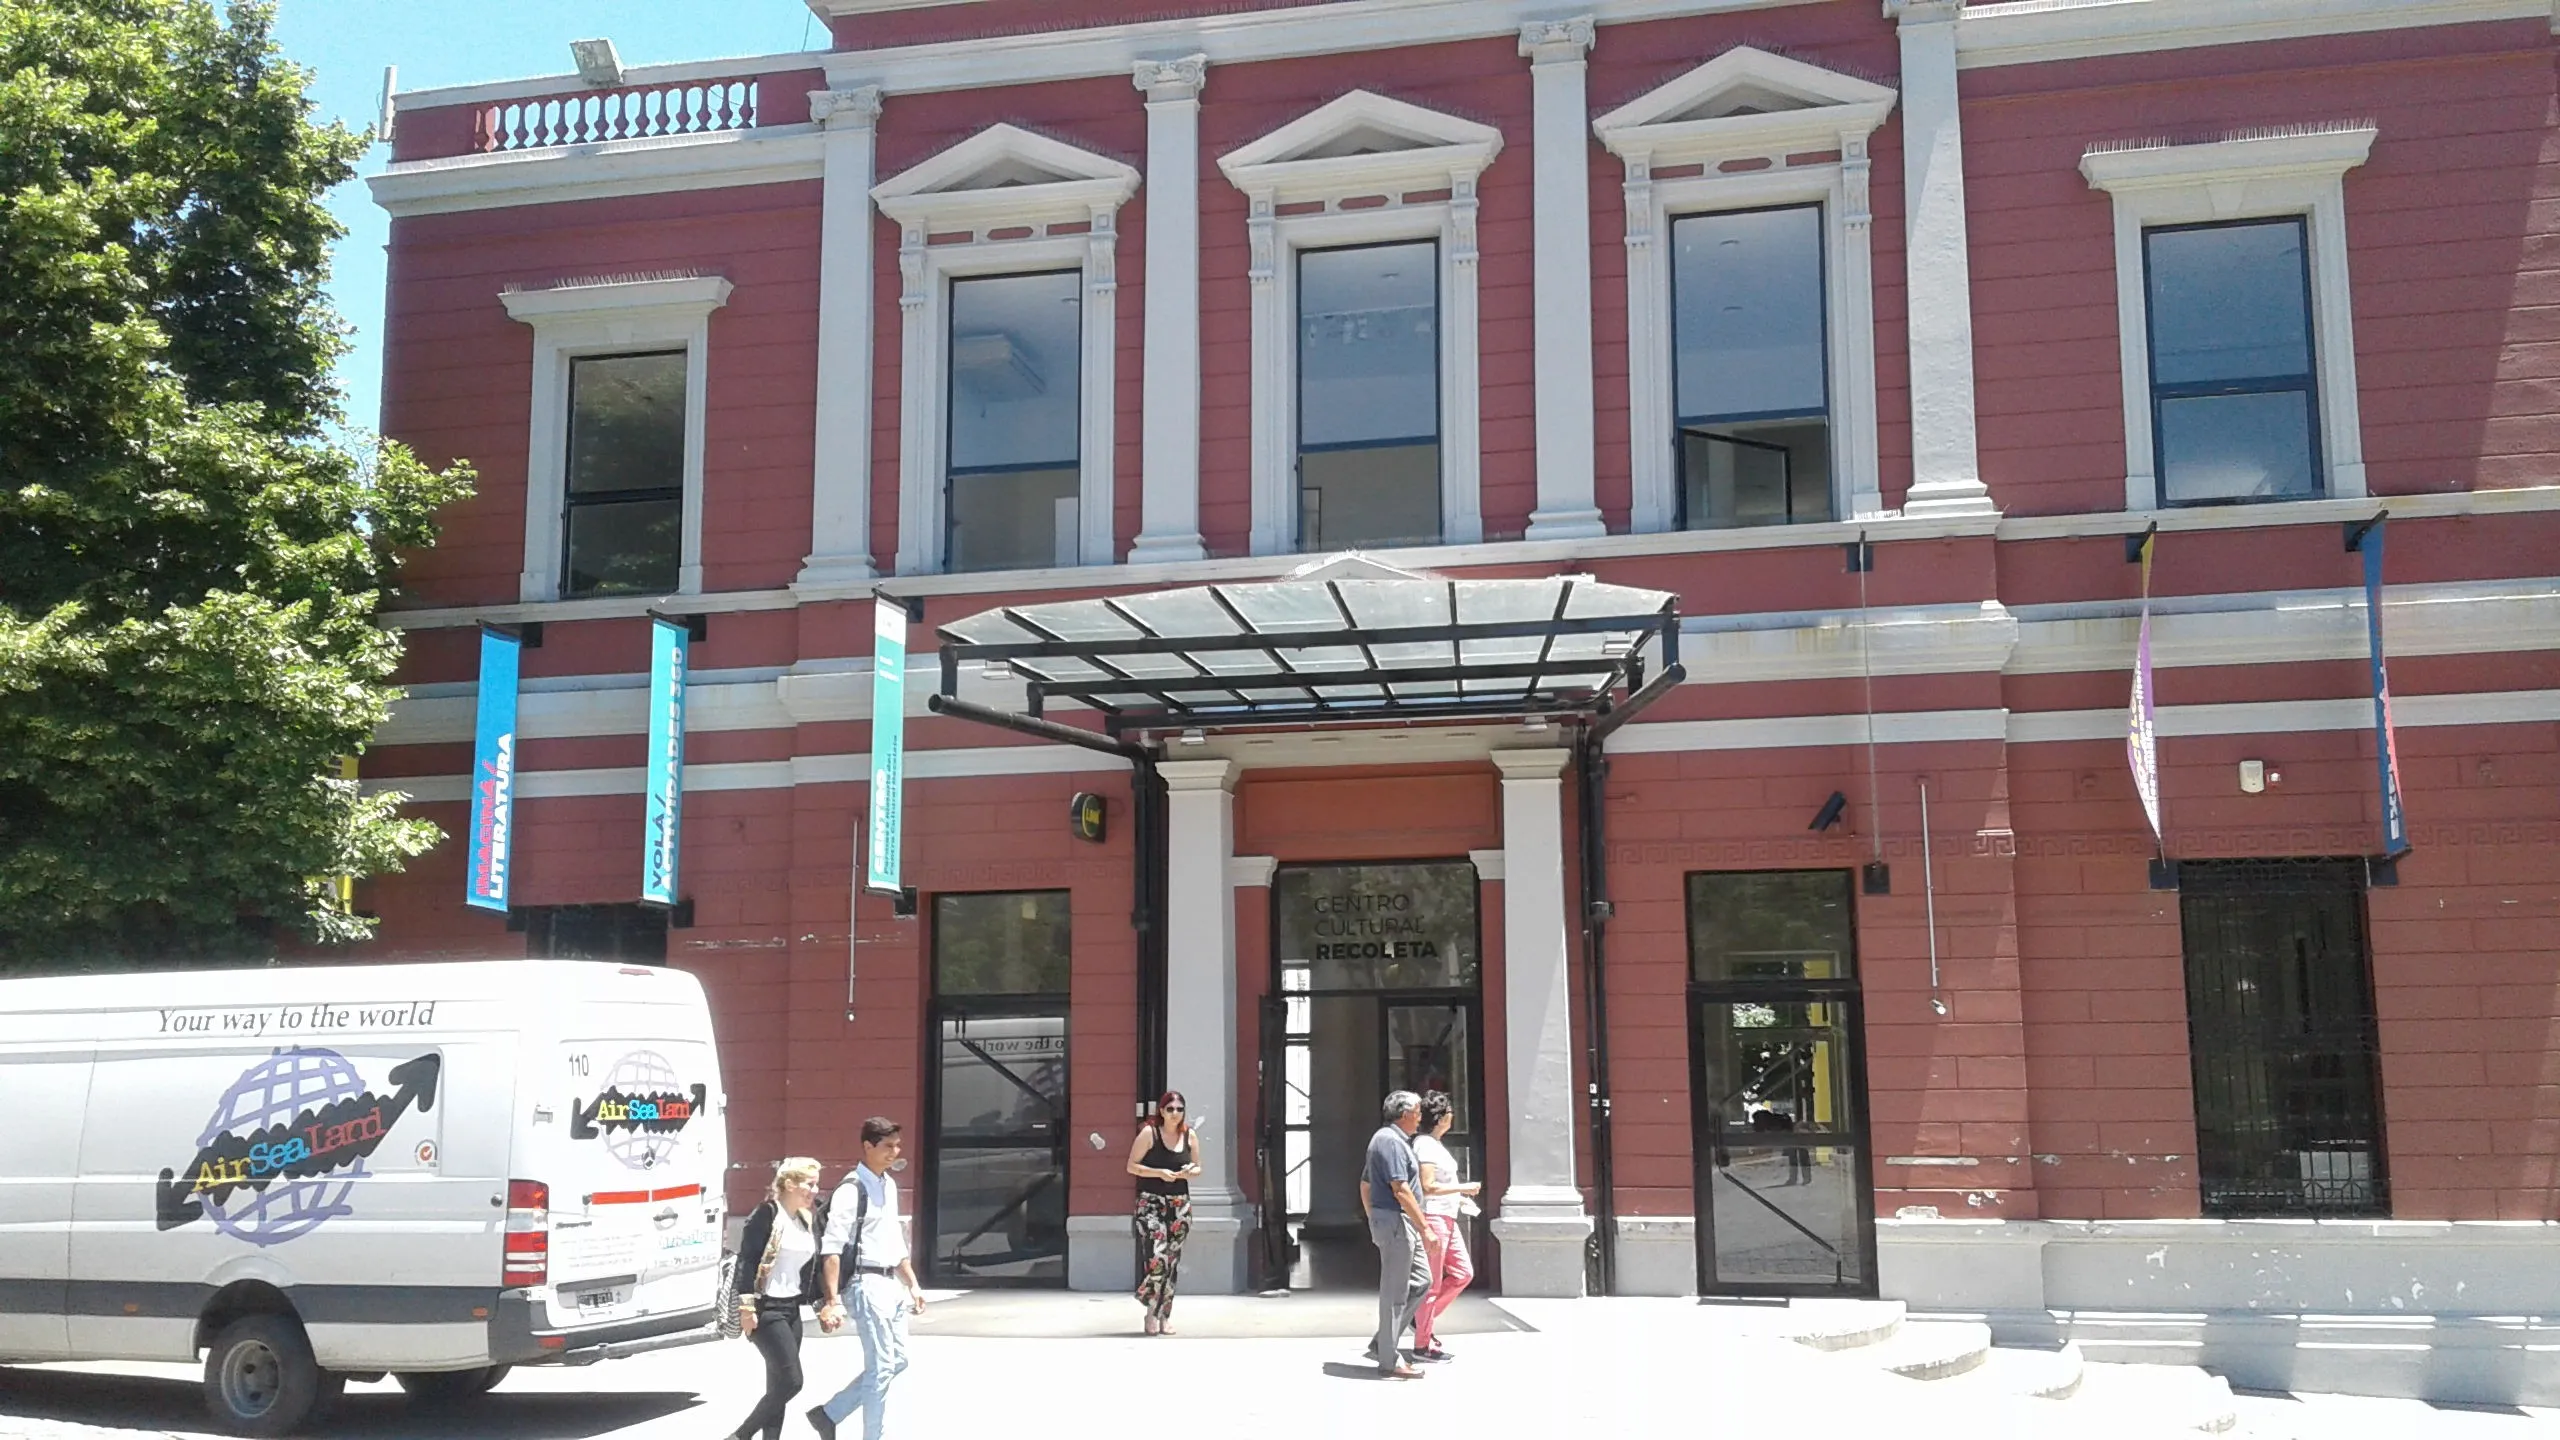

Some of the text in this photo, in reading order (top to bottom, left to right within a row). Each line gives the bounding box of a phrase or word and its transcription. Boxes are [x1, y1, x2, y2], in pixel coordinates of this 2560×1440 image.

[490, 733, 512, 899] LITERATURA
[1314, 894, 1410, 914] CENTRO
[1314, 915, 1426, 937] CULTURAL
[1316, 941, 1438, 960] RECOLETA
[158, 1000, 437, 1037] Your way to the world
[569, 1053, 590, 1076] 110
